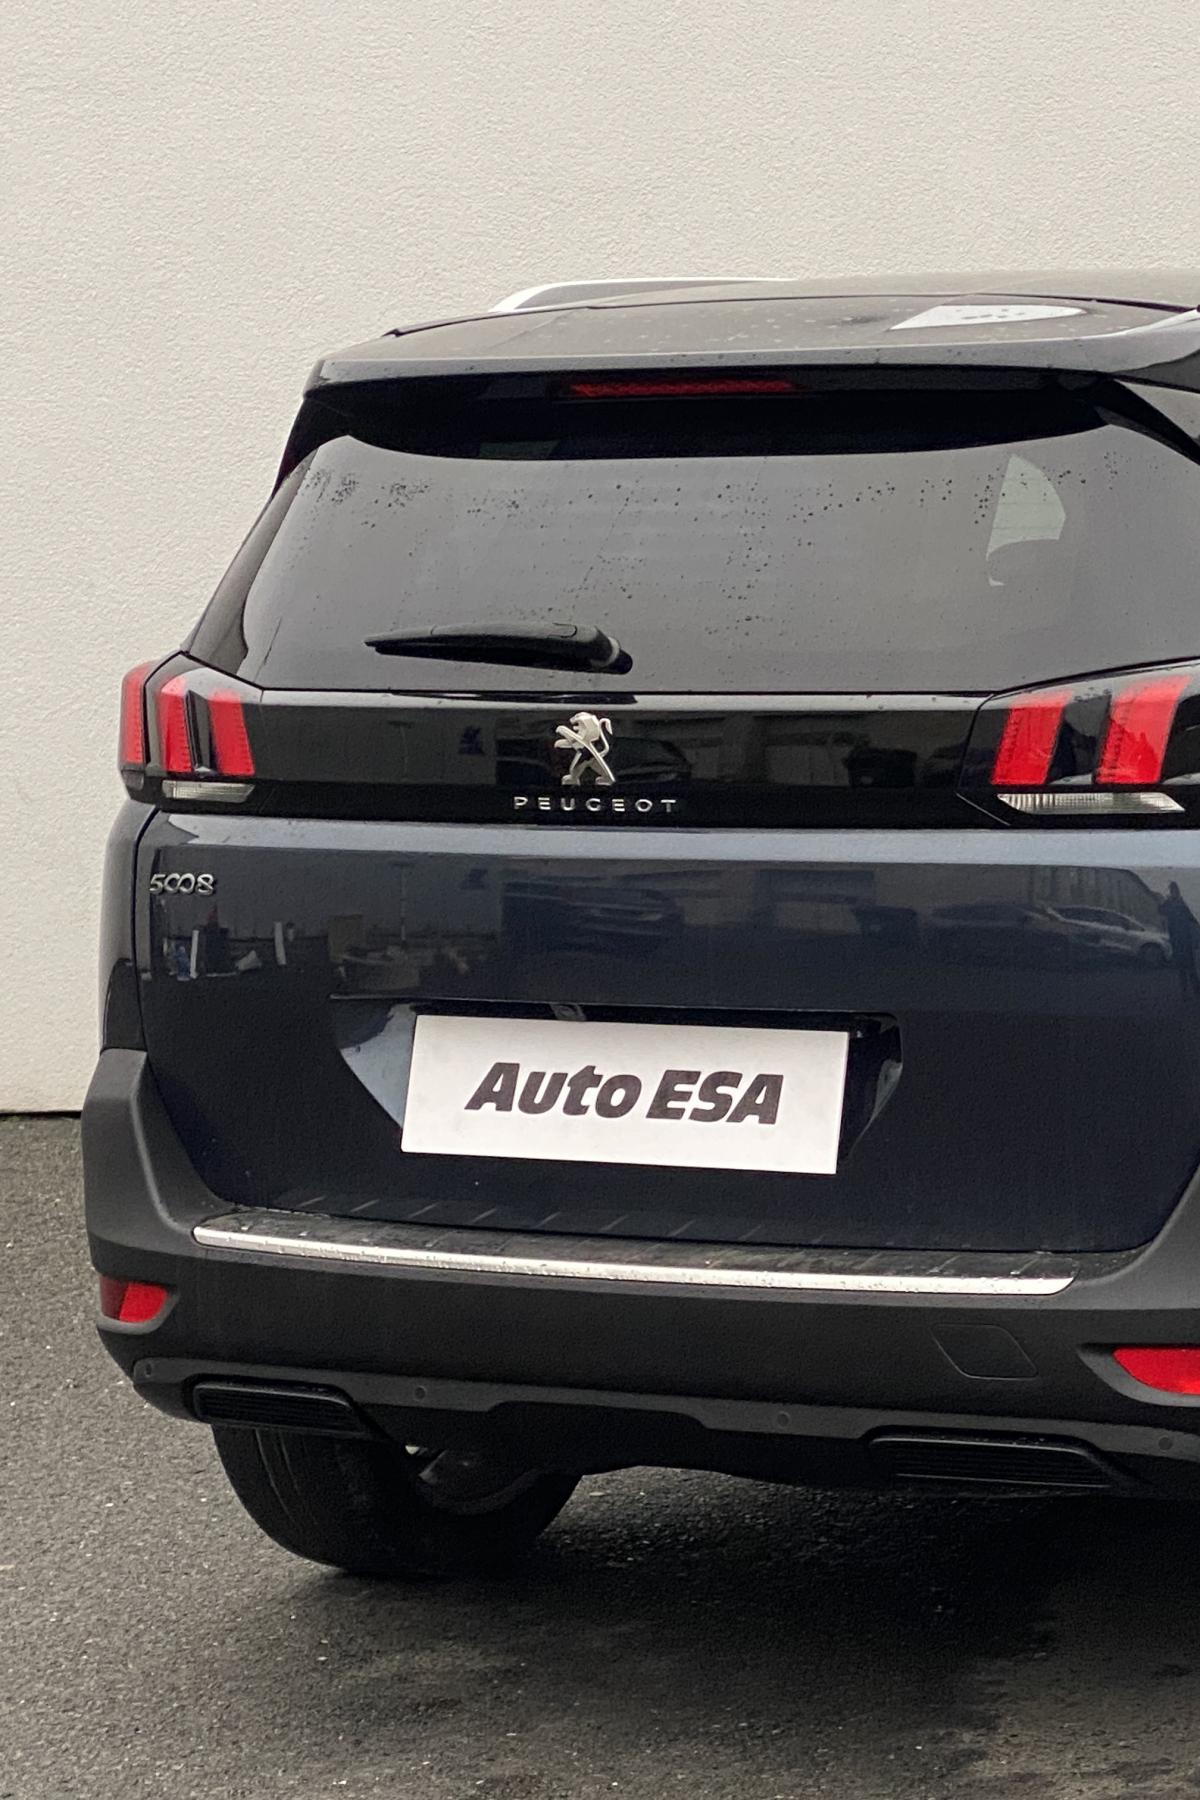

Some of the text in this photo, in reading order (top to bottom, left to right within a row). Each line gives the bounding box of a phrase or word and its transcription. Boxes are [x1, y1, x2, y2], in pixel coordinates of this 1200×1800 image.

[513, 795, 677, 813] PEUGEOT
[149, 872, 214, 895] 5008
[463, 1061, 785, 1125] Auto ESA
